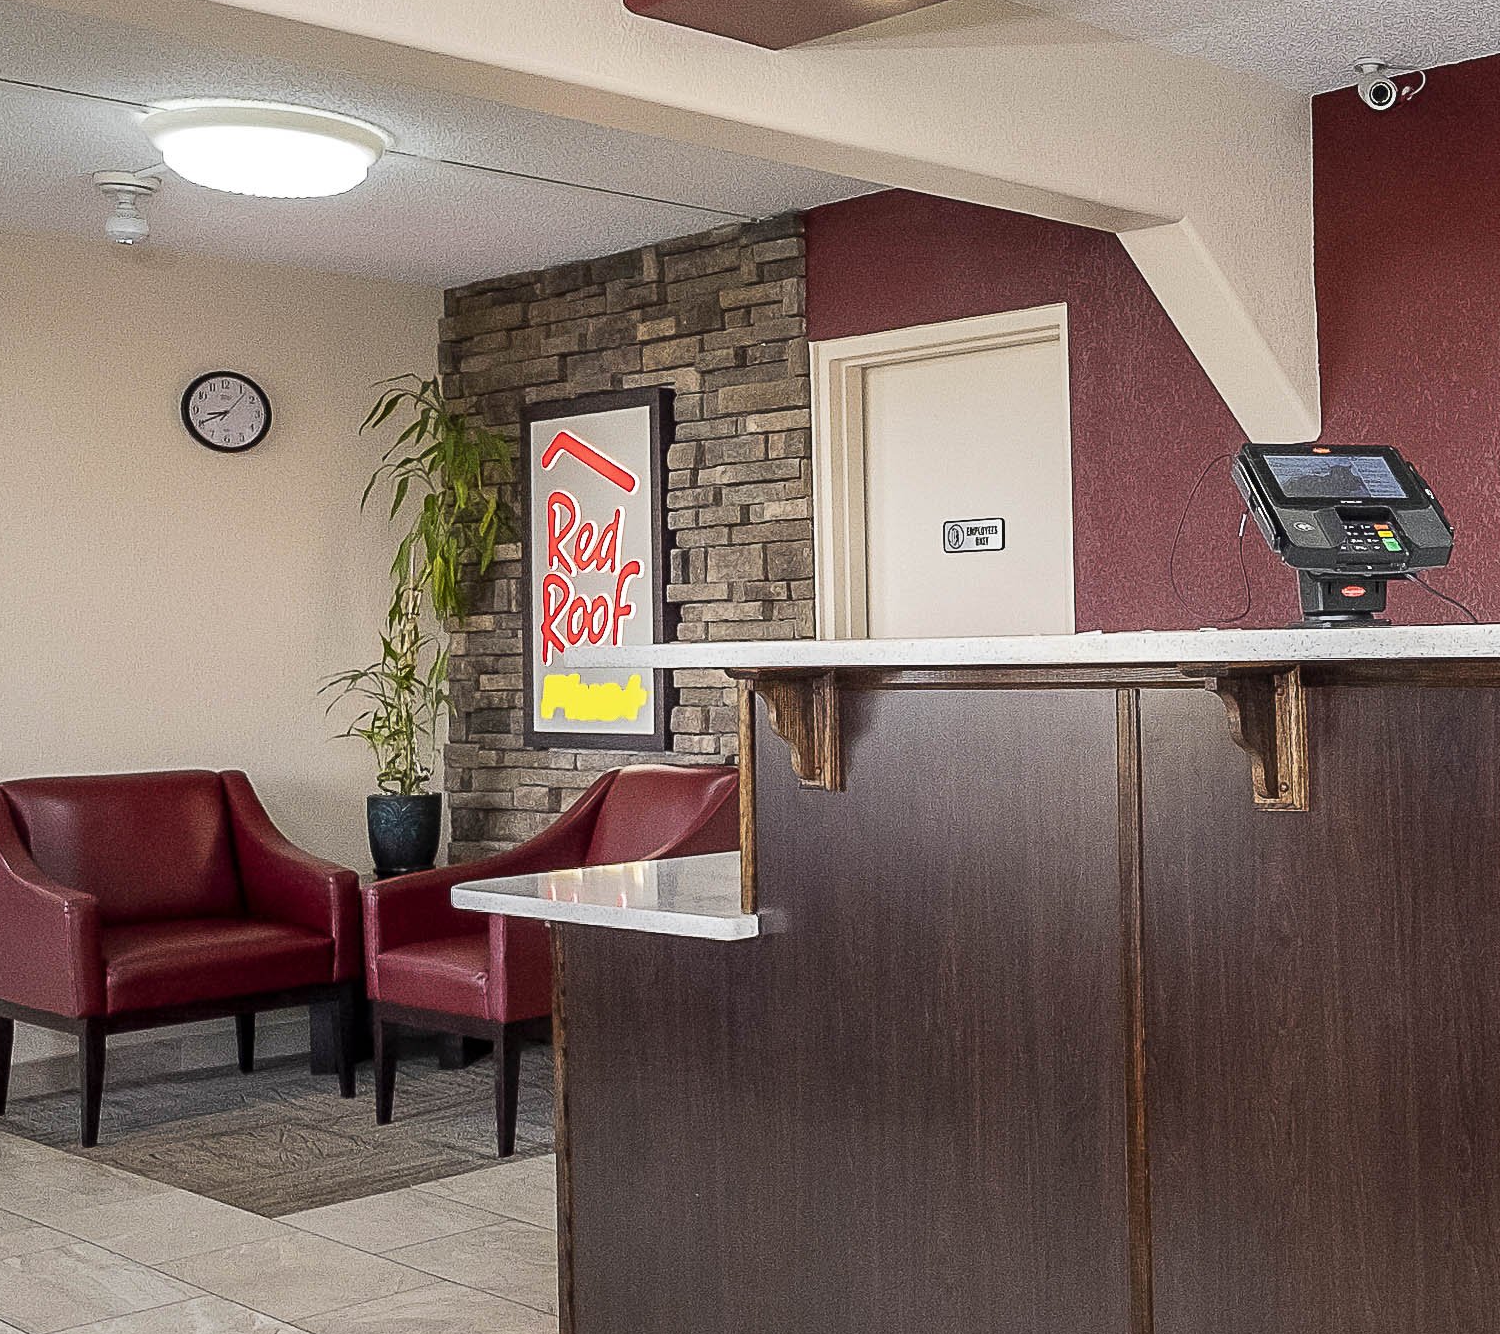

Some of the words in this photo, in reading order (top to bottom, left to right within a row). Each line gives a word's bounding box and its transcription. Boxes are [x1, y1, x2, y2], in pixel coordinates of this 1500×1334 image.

[547, 491, 626, 577] Red
[966, 525, 998, 536] EMPLOYEES
[541, 560, 645, 667] Roof
